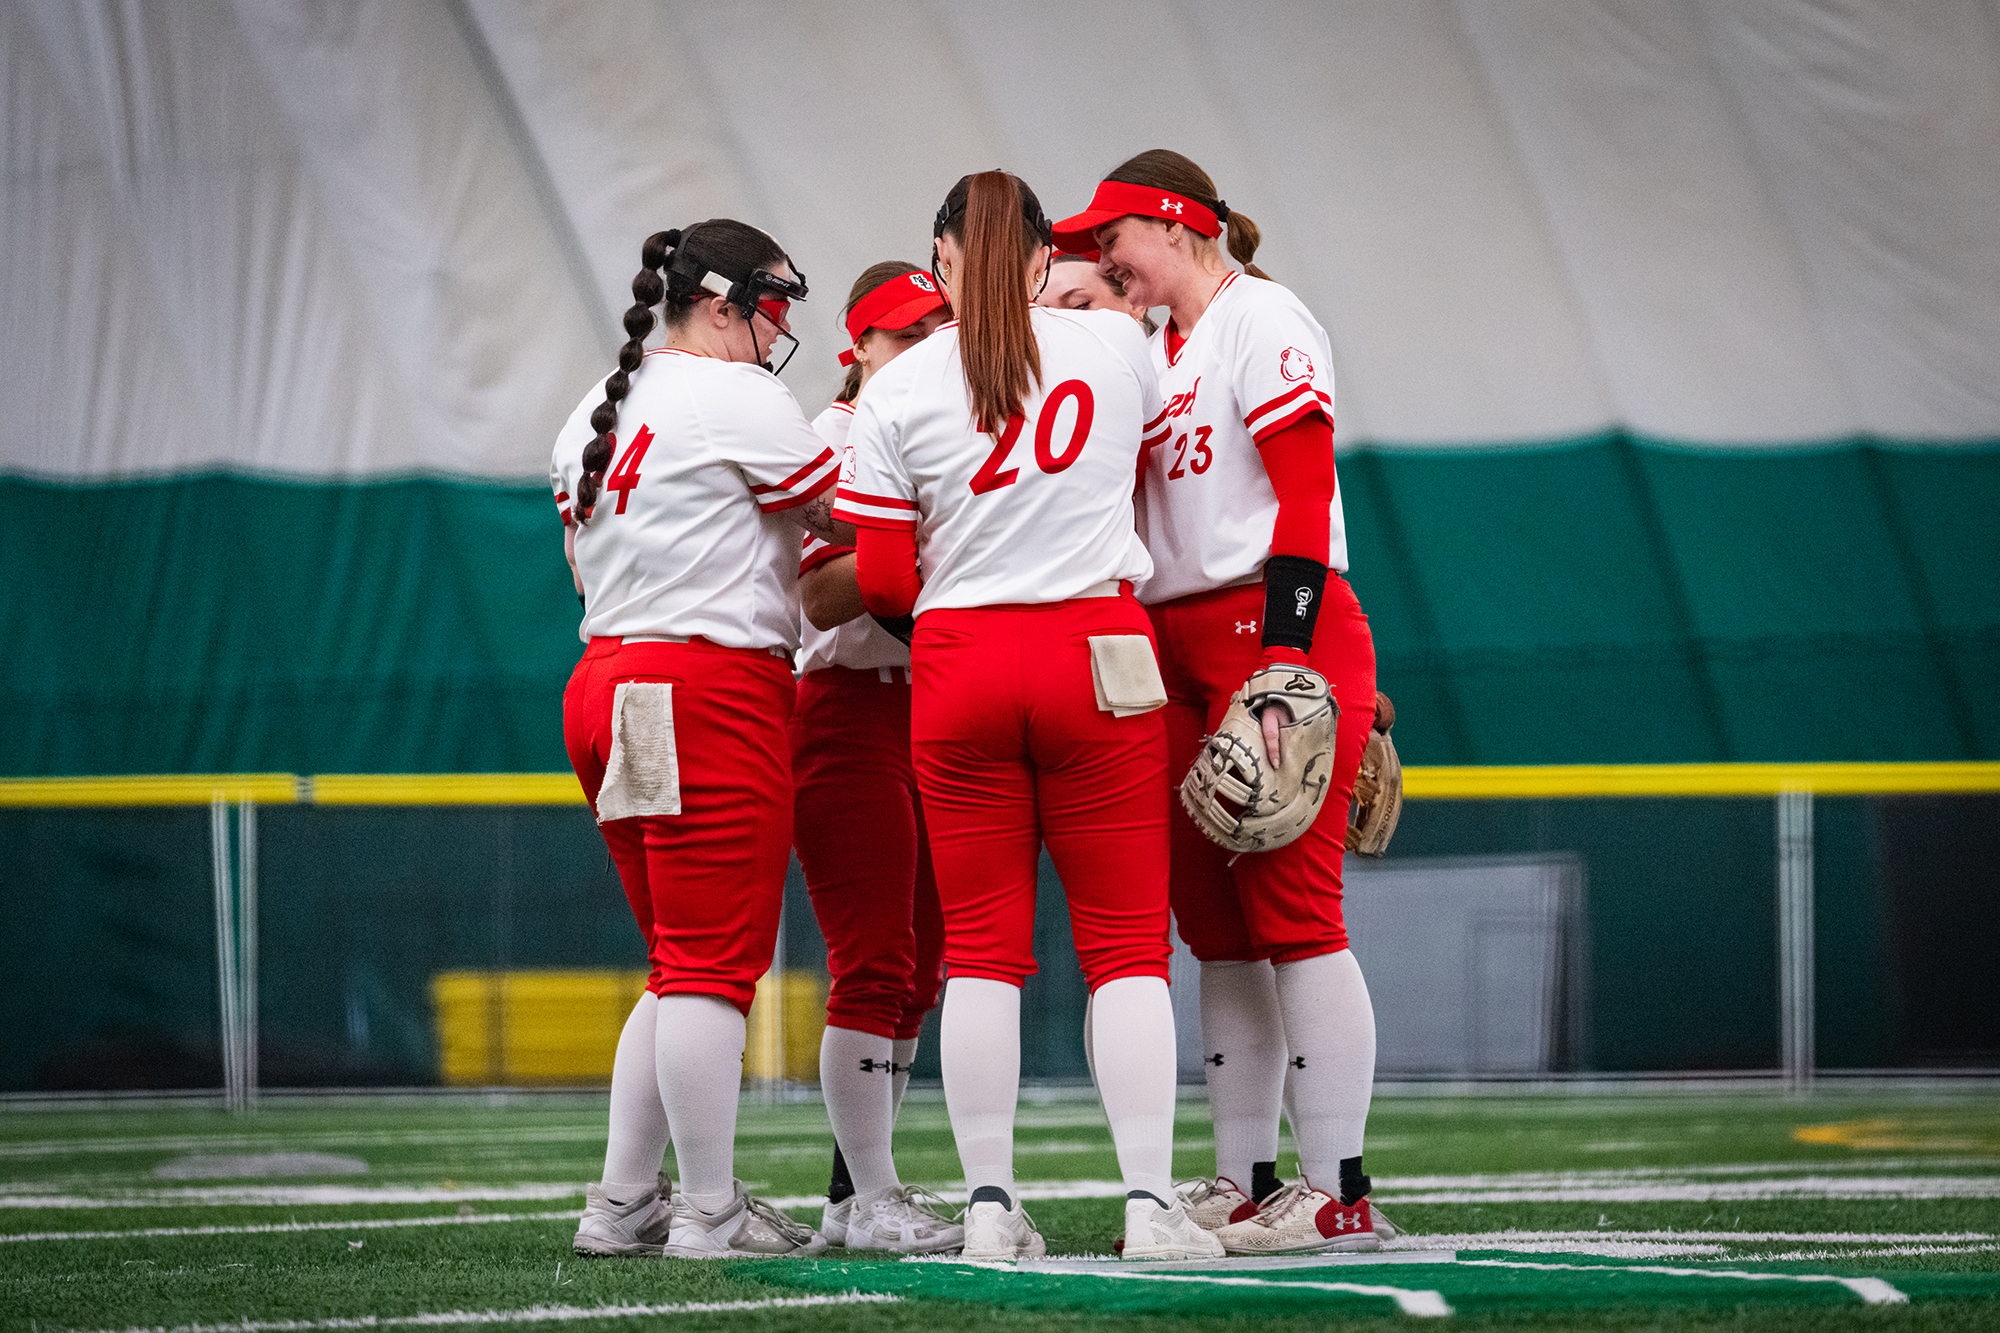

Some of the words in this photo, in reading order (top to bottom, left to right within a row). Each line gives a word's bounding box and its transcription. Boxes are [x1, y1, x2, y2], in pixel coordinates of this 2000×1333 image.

[968, 378, 1095, 497] 20
[1167, 424, 1214, 481] 23
[1295, 586, 1313, 620] TAG
